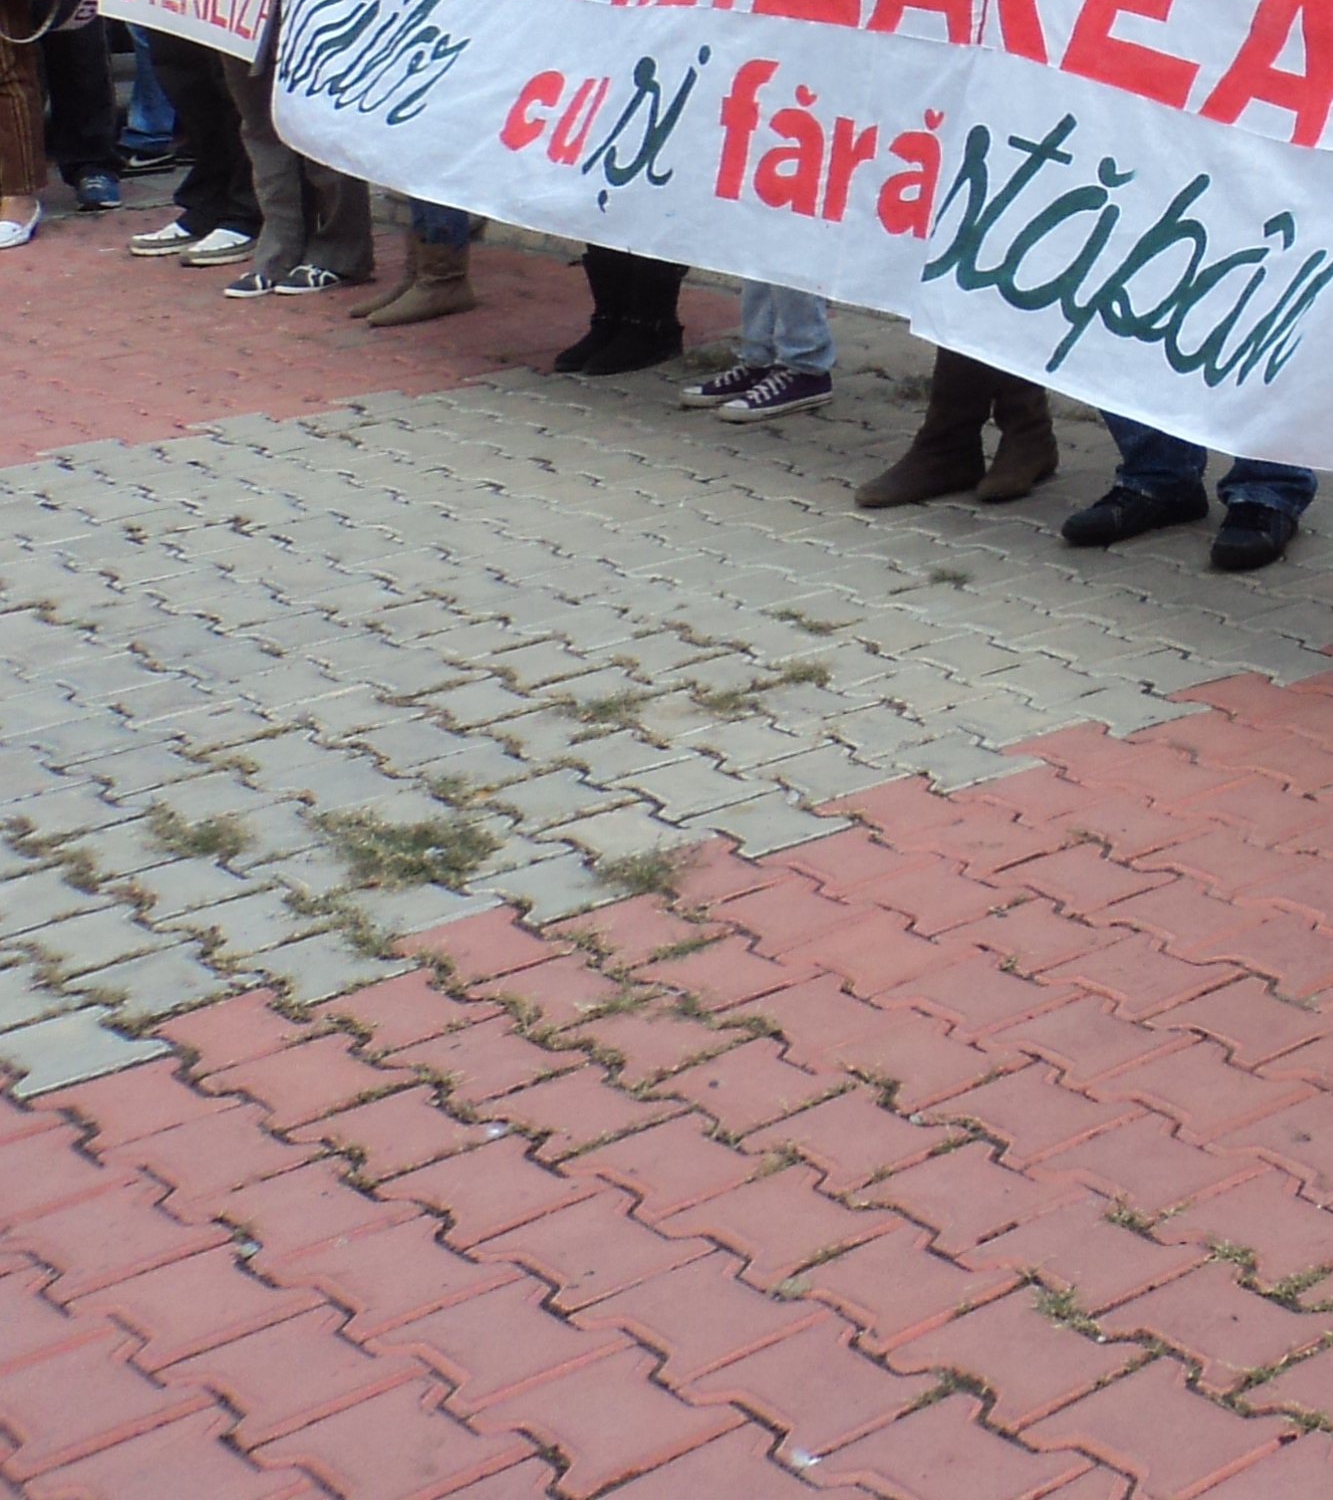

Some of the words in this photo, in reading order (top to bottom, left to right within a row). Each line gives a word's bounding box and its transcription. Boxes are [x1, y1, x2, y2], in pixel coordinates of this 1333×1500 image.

[500, 70, 611, 166] cu
[582, 44, 712, 214] și
[714, 57, 944, 241] fără
